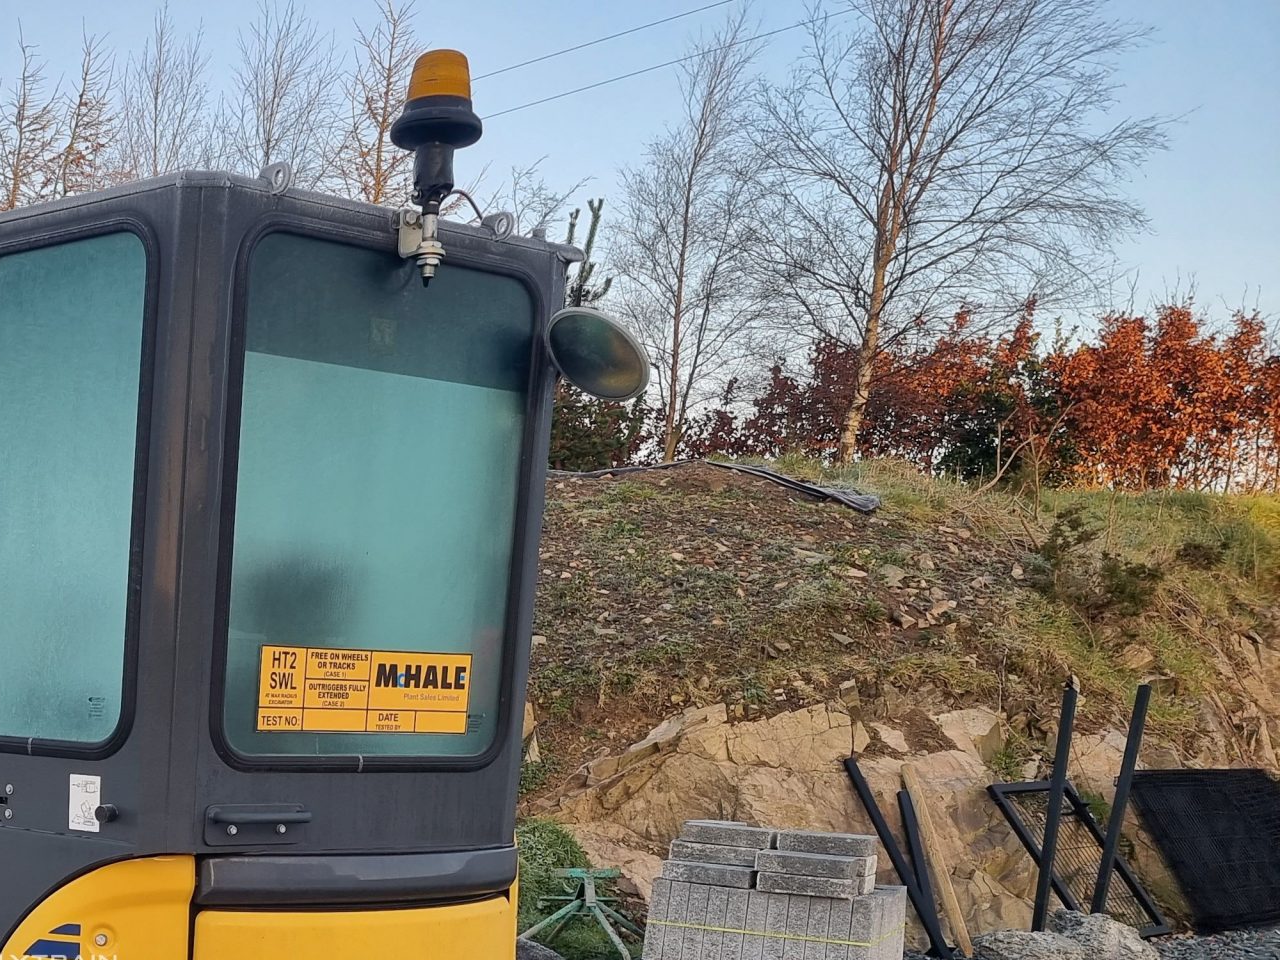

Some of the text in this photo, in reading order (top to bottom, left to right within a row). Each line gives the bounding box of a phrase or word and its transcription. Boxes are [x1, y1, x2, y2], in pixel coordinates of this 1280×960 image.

[272, 650, 297, 670] HT2
[311, 651, 369, 662] FREE ON WHEELS
[317, 661, 355, 670] OR TRACKS
[270, 671, 297, 690] SWL
[375, 663, 467, 690] McHALE
[308, 683, 366, 692] OUTRIGGERS FULLY
[317, 691, 349, 700] EXTENDED
[403, 693, 460, 702] Plant Sales Limited
[322, 700, 339, 708] (CASE
[261, 715, 300, 727] TEST NO:
[378, 713, 399, 722] DATE
